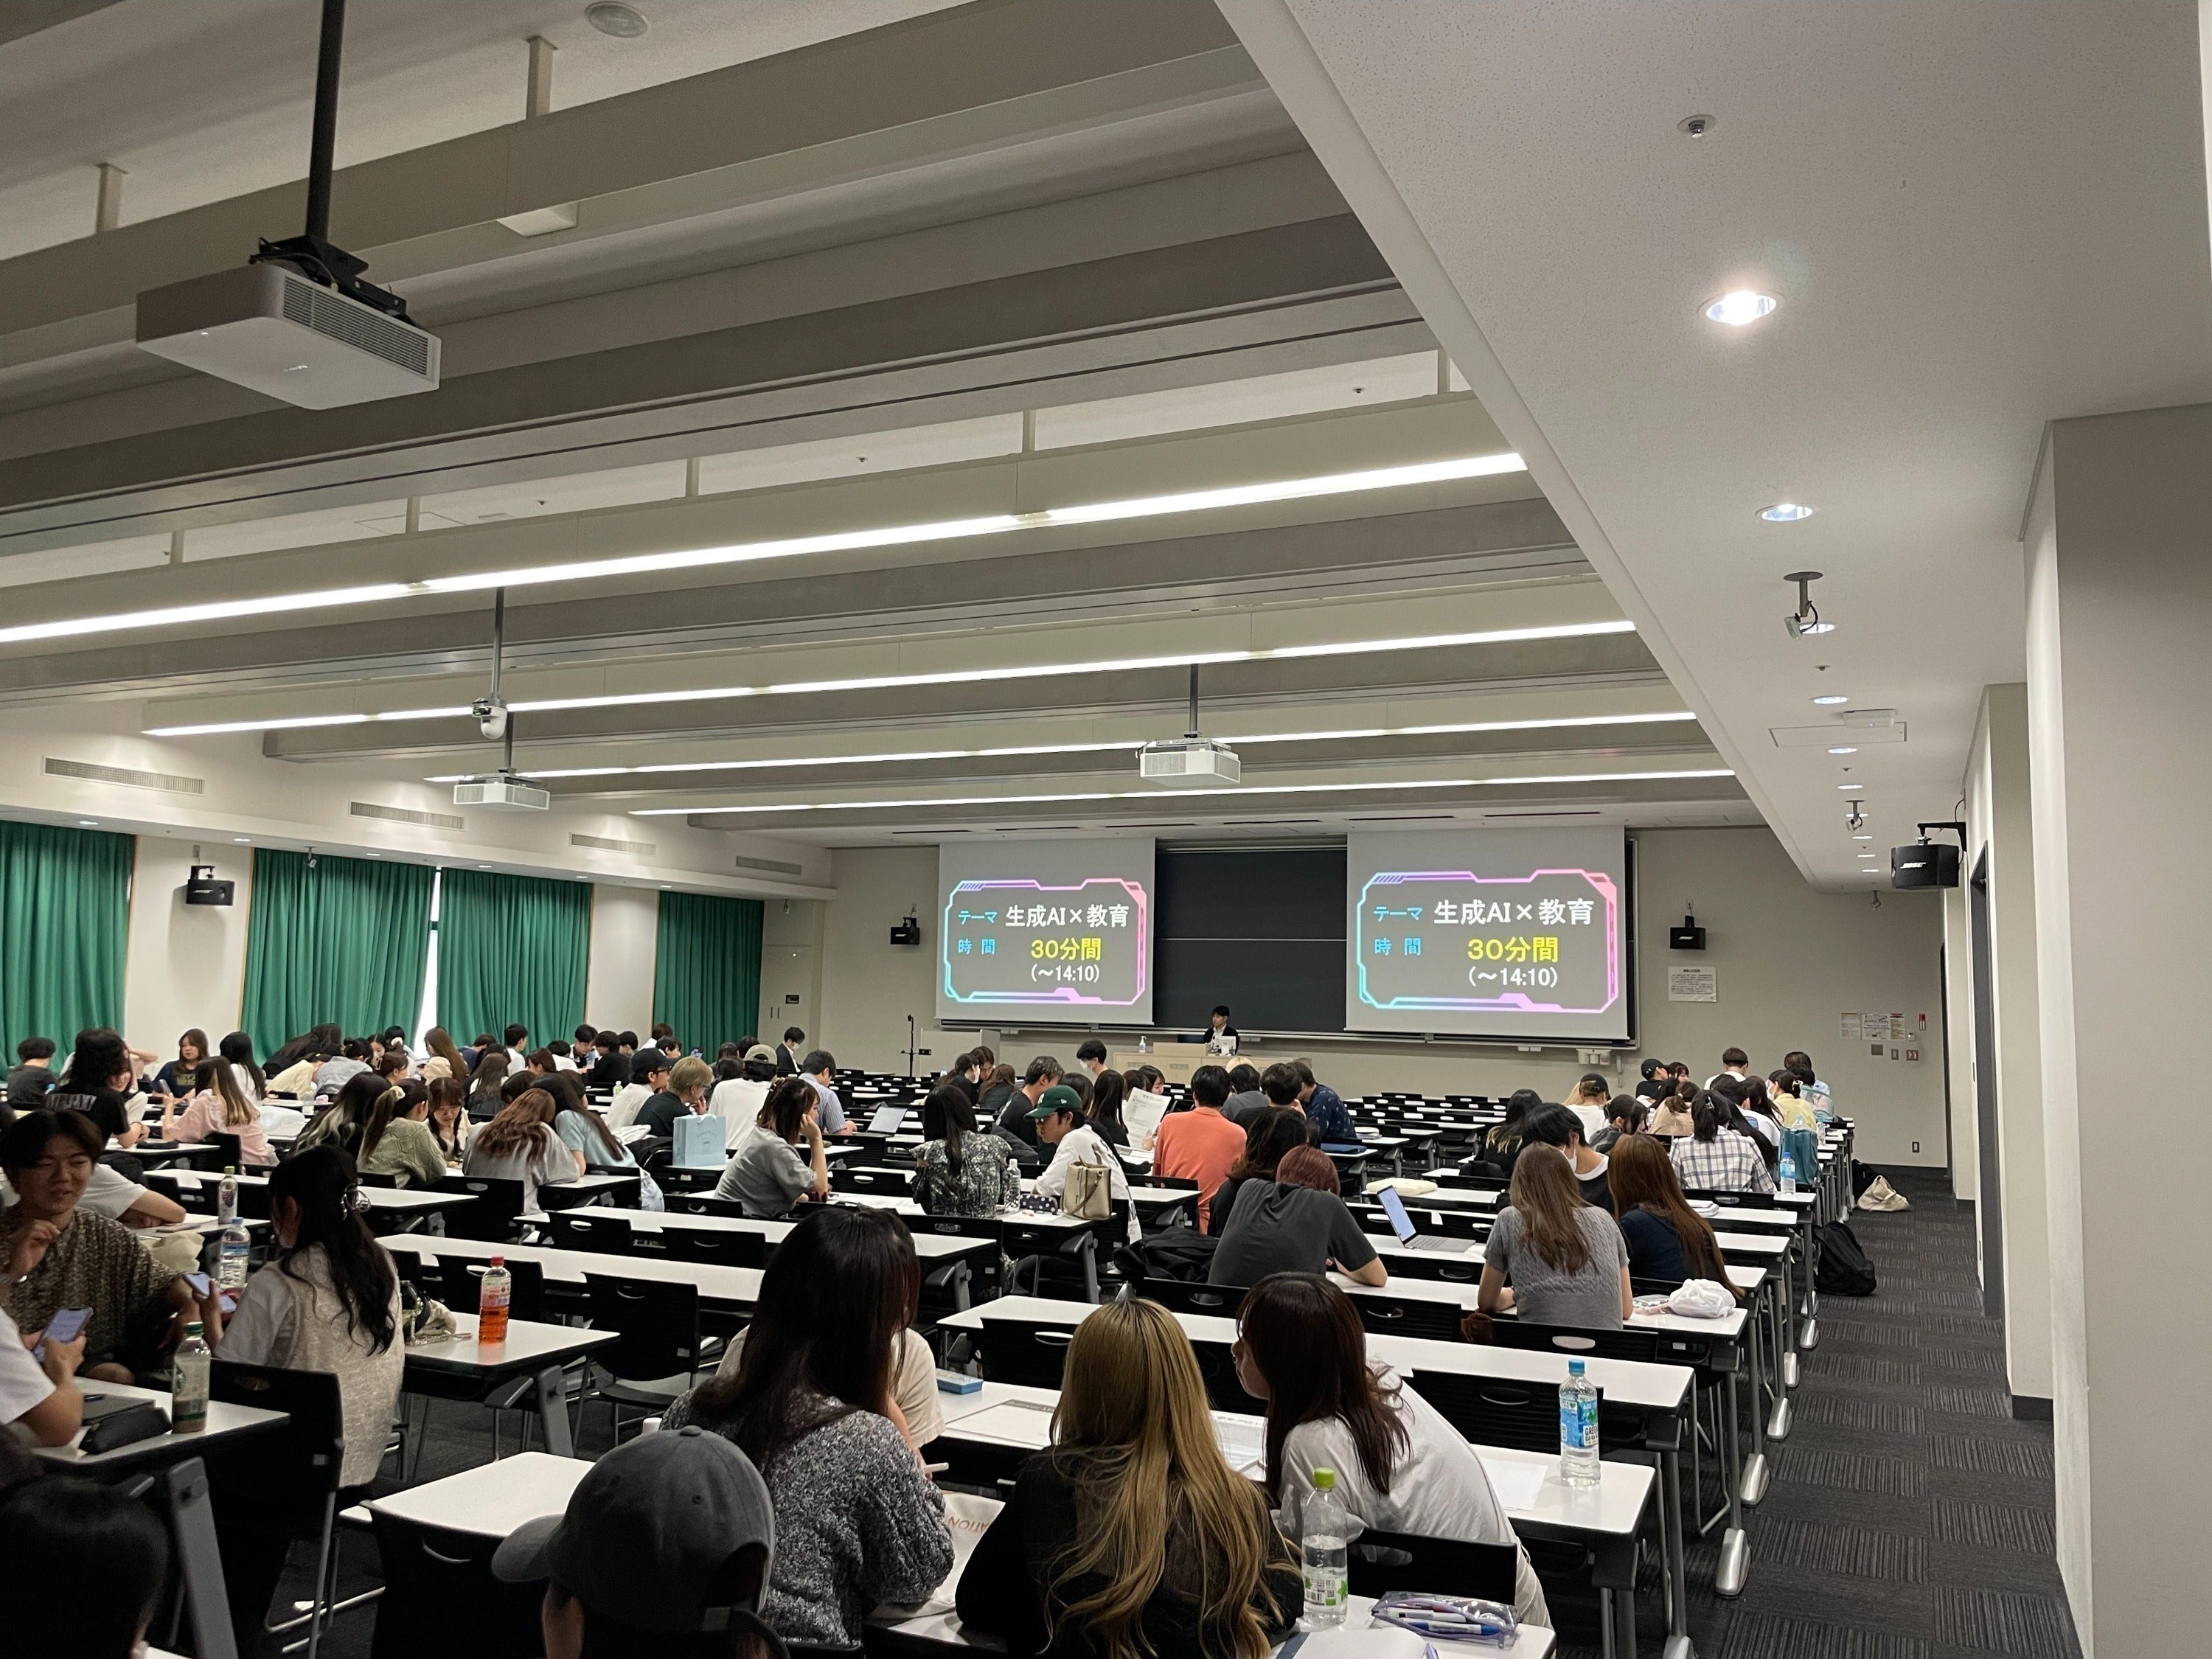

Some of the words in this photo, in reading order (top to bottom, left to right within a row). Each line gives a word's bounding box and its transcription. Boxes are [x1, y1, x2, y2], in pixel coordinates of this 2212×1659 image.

[958, 910, 997, 925] テーマ
[1374, 906, 1422, 922] テーマ
[1031, 937, 1102, 961] 30分間
[1467, 936, 1558, 963] 30分間
